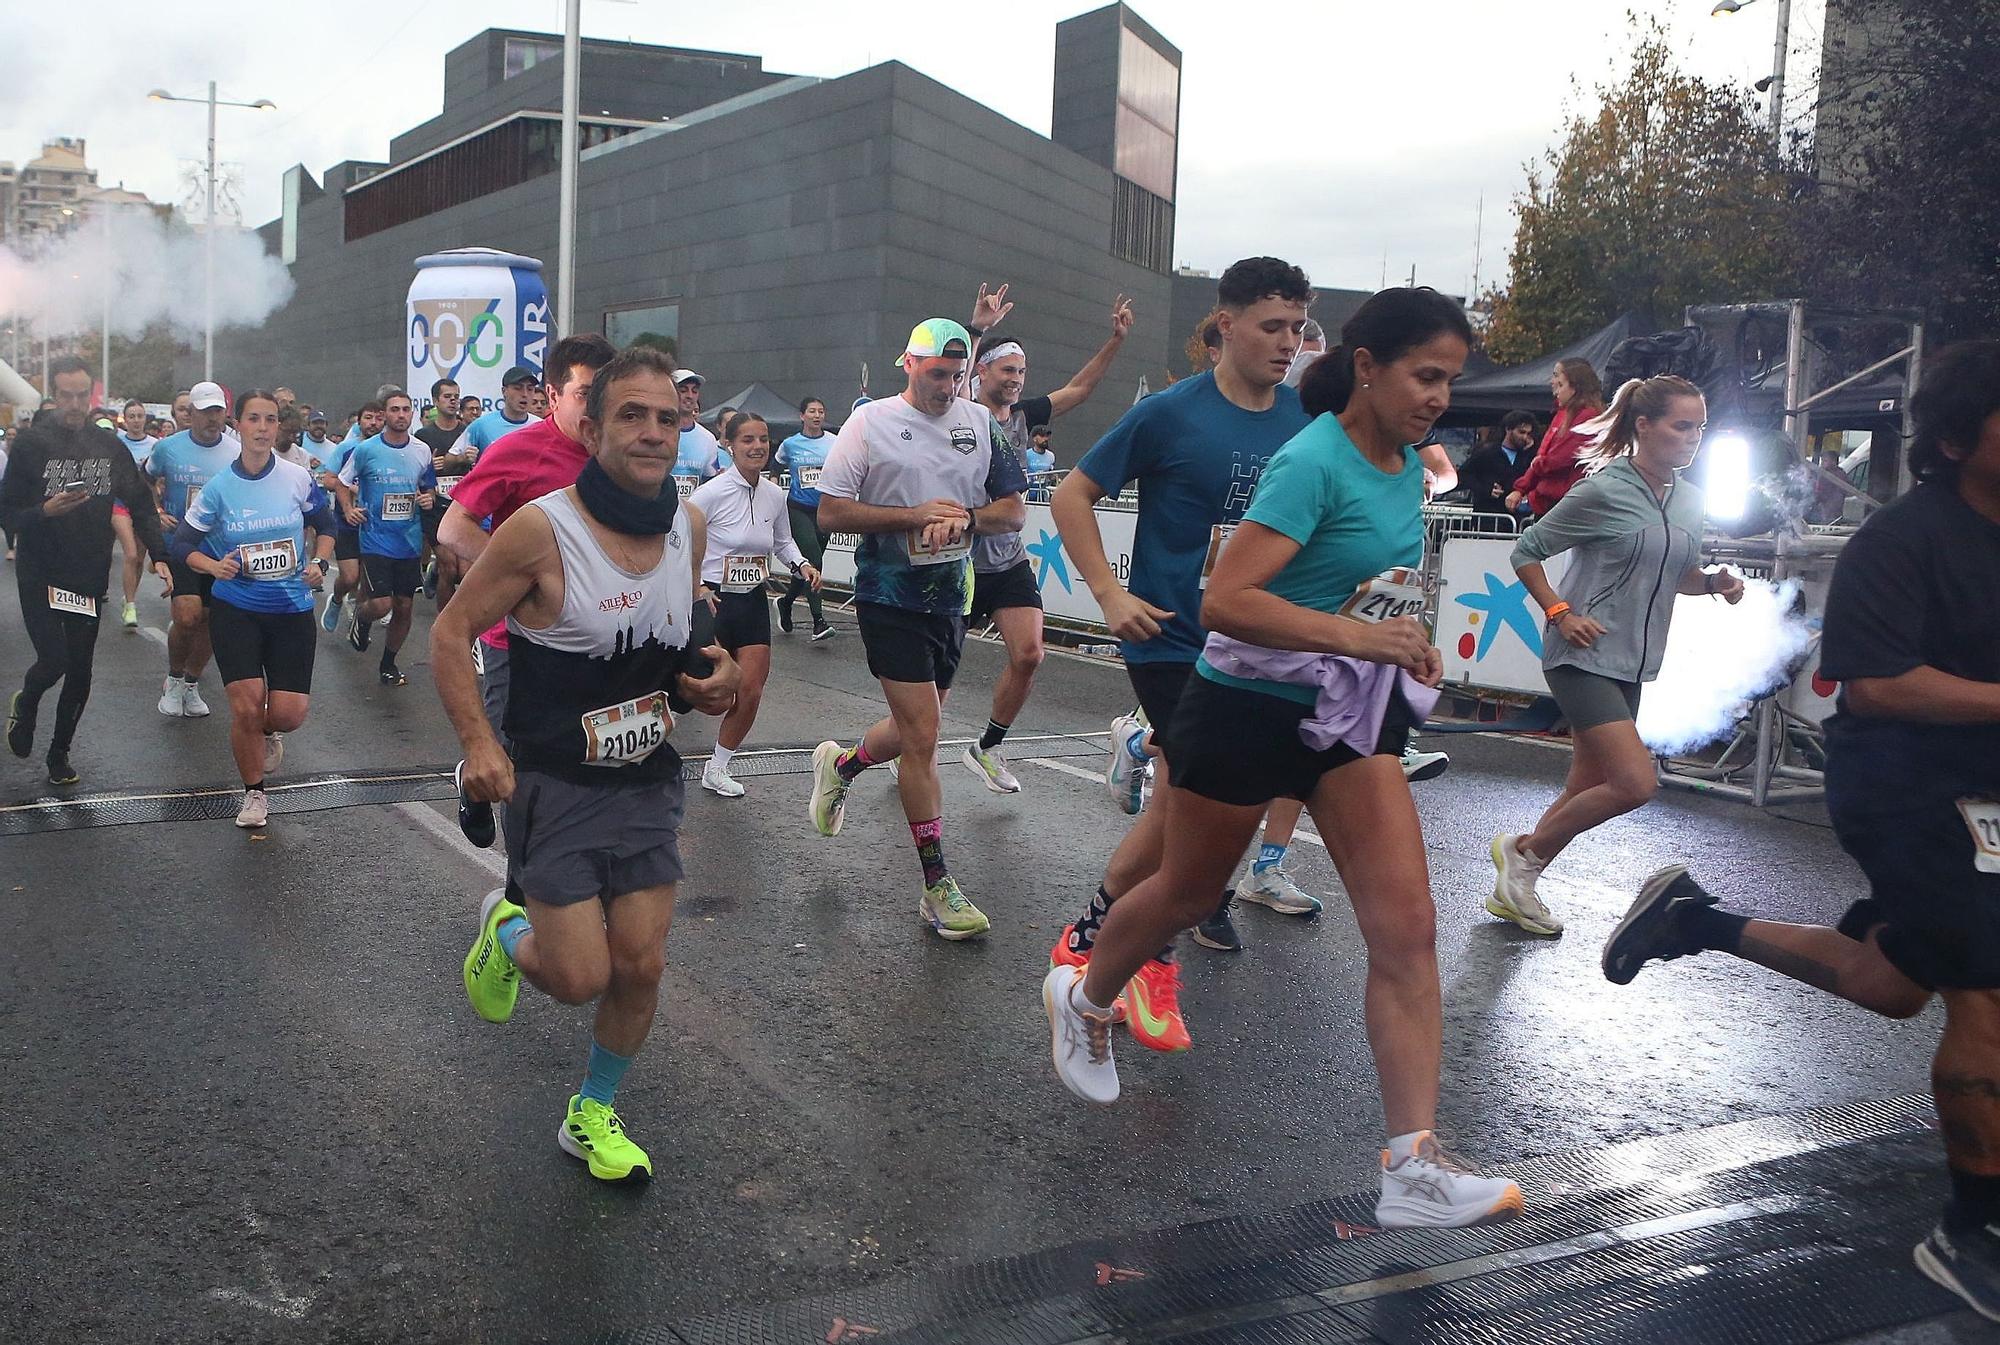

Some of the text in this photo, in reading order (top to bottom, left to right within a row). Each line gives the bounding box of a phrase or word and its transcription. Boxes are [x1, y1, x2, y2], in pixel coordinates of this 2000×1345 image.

[523, 302, 547, 384] AR
[677, 485, 692, 495] 1351
[389, 502, 410, 513] 21352
[252, 554, 287, 572] 21370
[730, 568, 761, 582] 21060
[56, 591, 88, 607] 21403
[602, 721, 661, 761] 21045
[471, 934, 494, 981] TERREX
